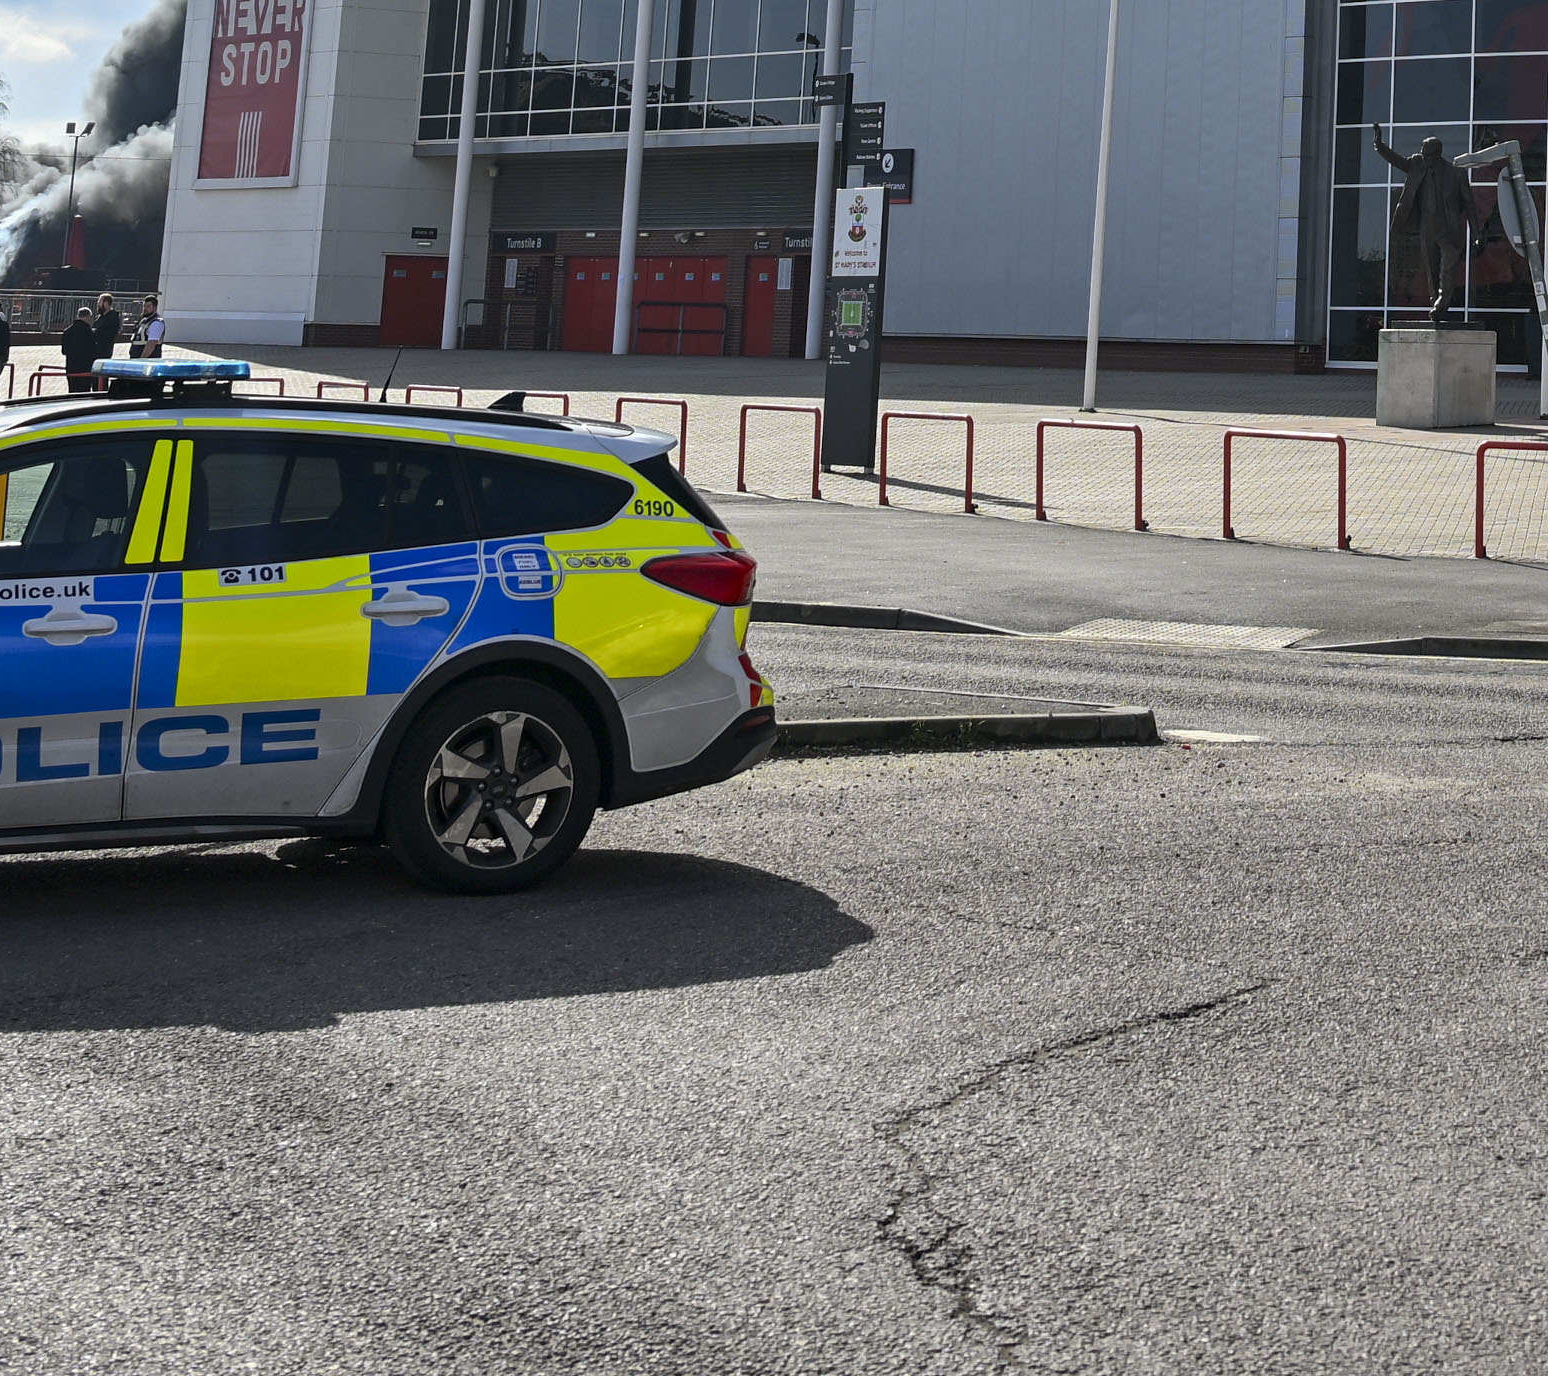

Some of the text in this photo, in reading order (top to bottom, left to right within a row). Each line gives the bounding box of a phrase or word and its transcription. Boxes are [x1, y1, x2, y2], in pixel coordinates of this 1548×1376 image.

[220, 39, 292, 87] STOP
[507, 237, 542, 249] Turnstile B
[633, 499, 675, 518] 6190
[247, 564, 286, 582] 101
